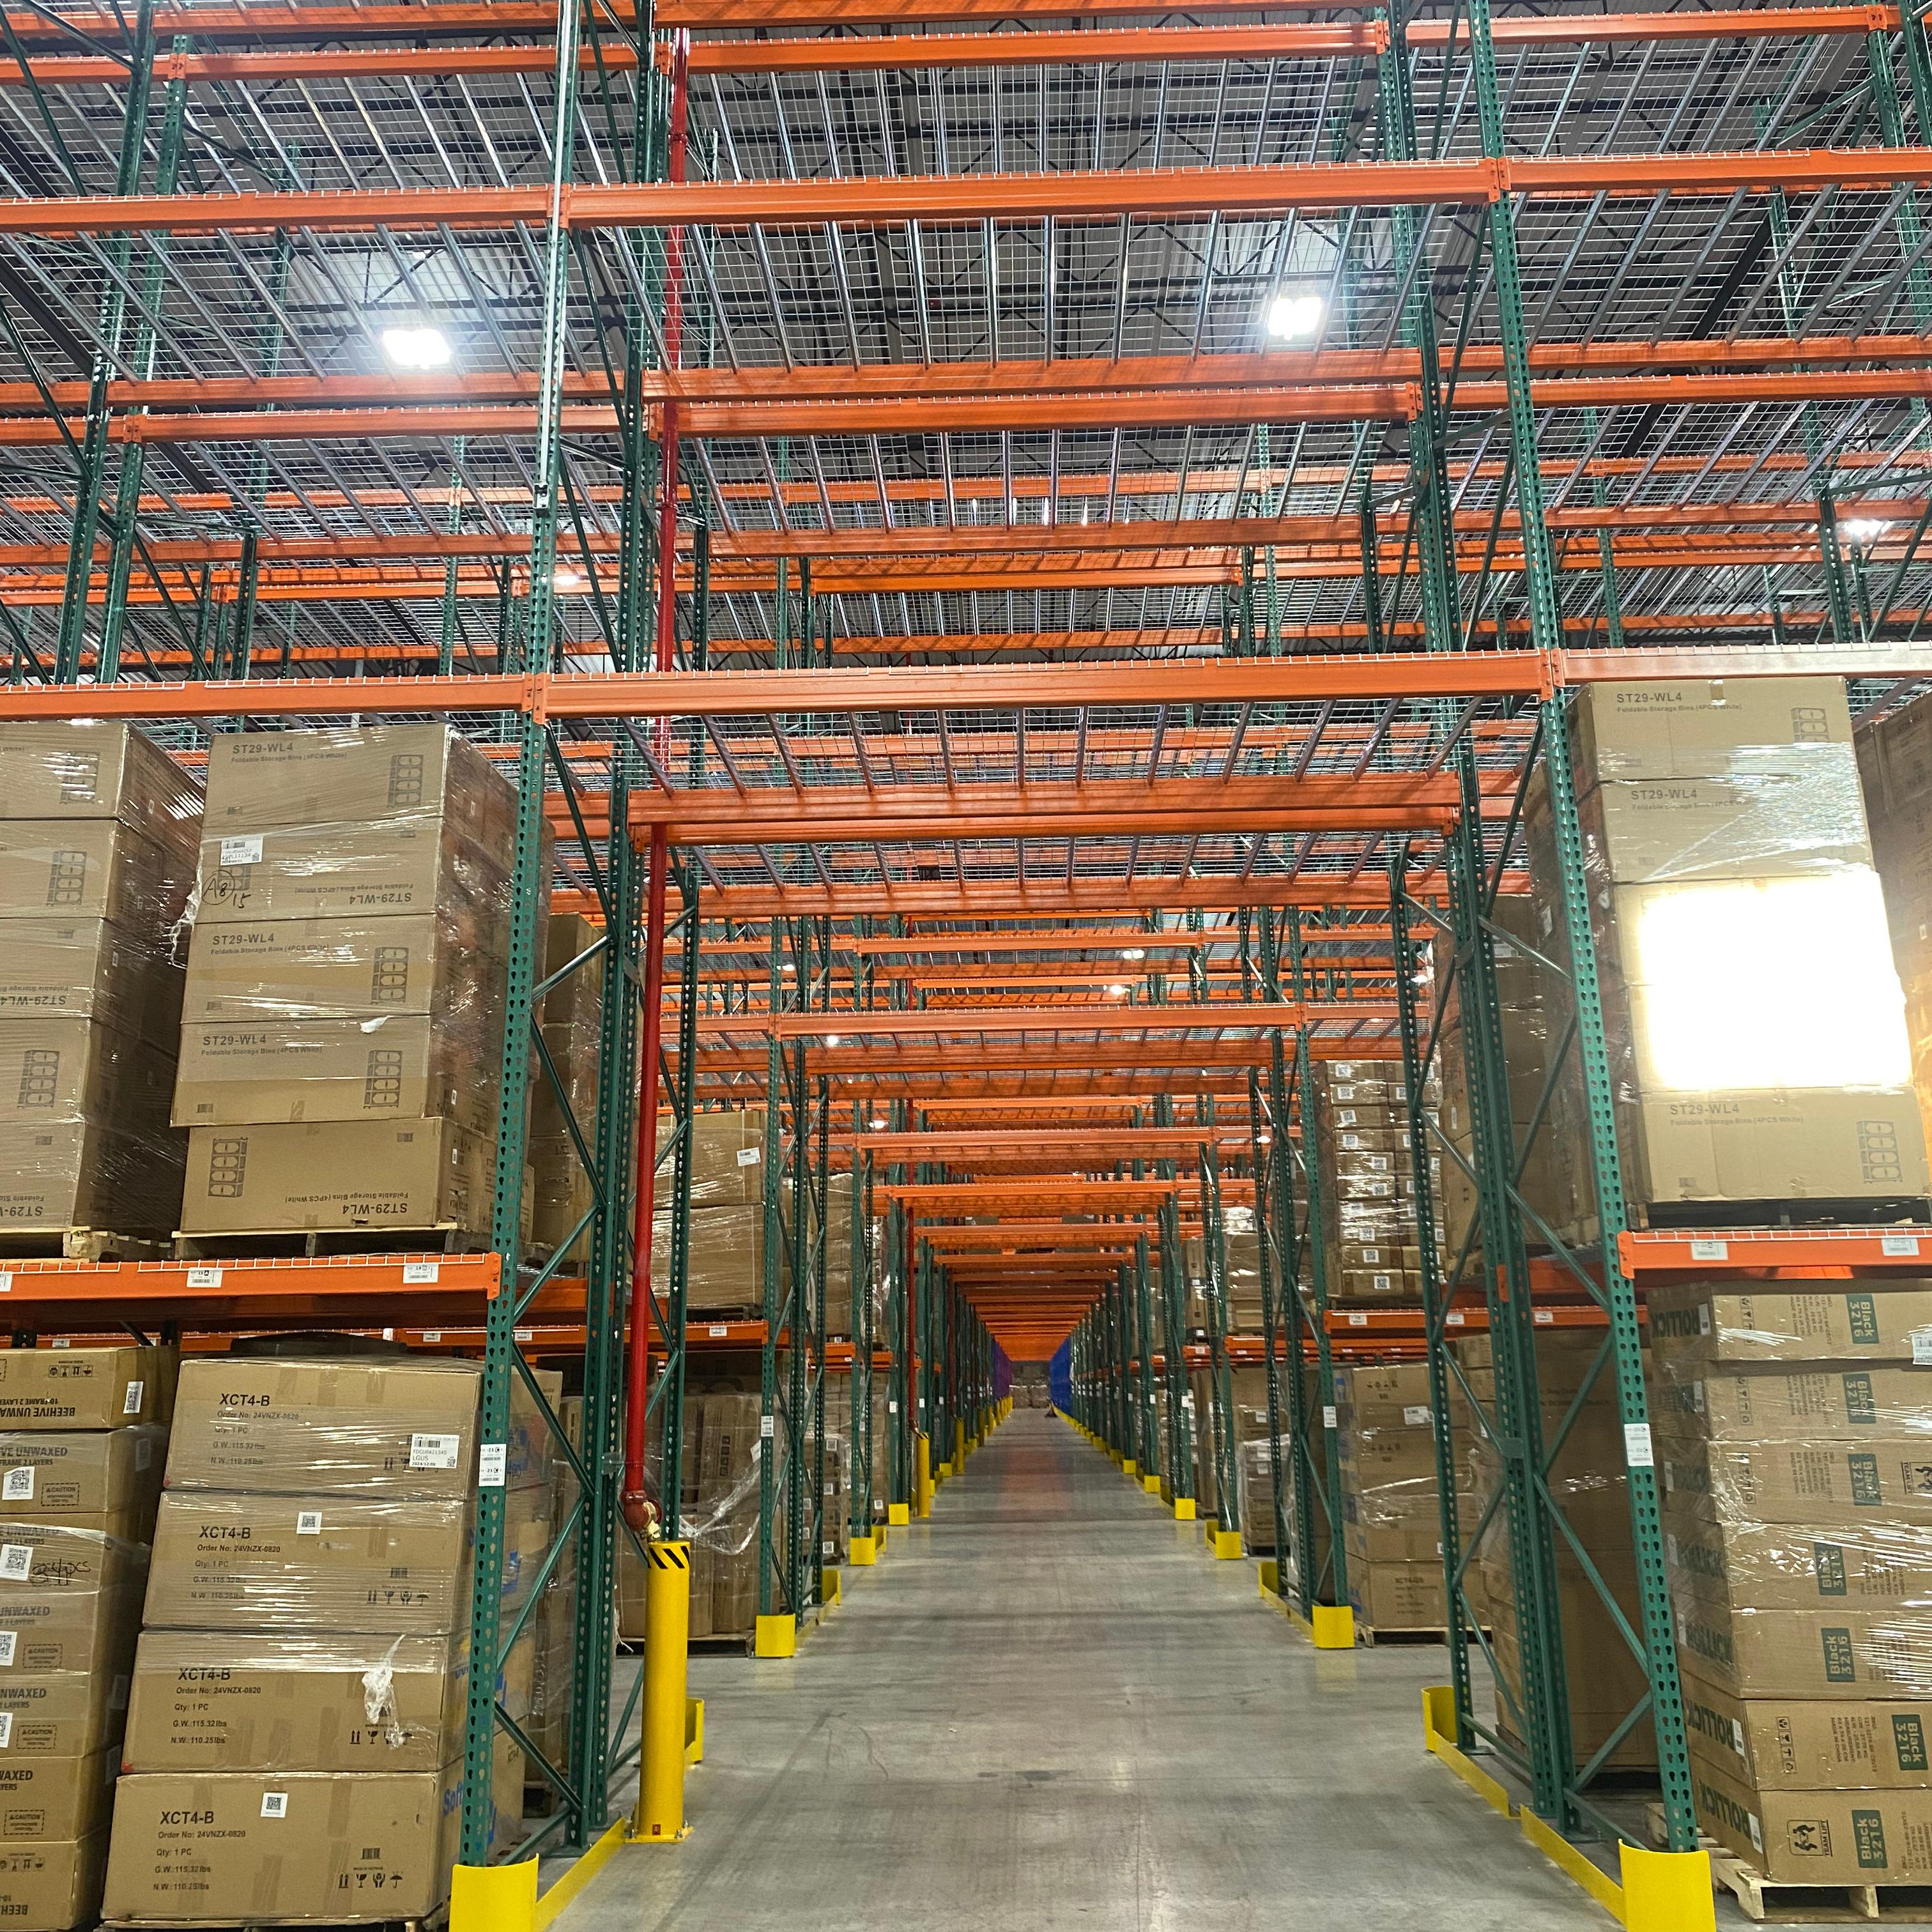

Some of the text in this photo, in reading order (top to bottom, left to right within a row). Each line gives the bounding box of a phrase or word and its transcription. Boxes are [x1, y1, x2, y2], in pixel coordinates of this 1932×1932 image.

[1616, 692, 1682, 703] ST29-WL4
[232, 742, 293, 754] ST29-WL4
[1631, 790, 1698, 800] ST29-WL4
[349, 893, 412, 905] ST29-WL4
[212, 933, 275, 945] ST29-WL4
[0, 995, 66, 1006] ST29-WL4
[203, 1034, 266, 1045] ST29-WL4
[1669, 1103, 1739, 1115] ST29-WL4
[342, 1203, 408, 1215] ST29-WL4
[1850, 1301, 1864, 1337] 3216
[1860, 1301, 1875, 1337] Black
[220, 1393, 270, 1406] XCT4-B
[33, 1407, 75, 1418] BEEHIVE
[16, 1446, 68, 1457] UNWAXED
[1852, 1461, 1866, 1498] 3216
[1864, 1461, 1878, 1498] Black
[199, 1526, 251, 1538] XCT4-B
[195, 1560, 210, 1568] Qty:
[1826, 1636, 1840, 1674] Black
[1837, 1636, 1851, 1674] 3216
[178, 1667, 231, 1680] XCT4-B
[174, 1703, 190, 1712] Qty:
[1896, 1722, 1911, 1763] 3216
[1907, 1722, 1923, 1763] Black
[160, 1811, 215, 1825] XCT4-B
[1857, 1818, 1872, 1860] Black
[1868, 1818, 1883, 1860] 3216
[157, 1848, 172, 1857] Qty:
